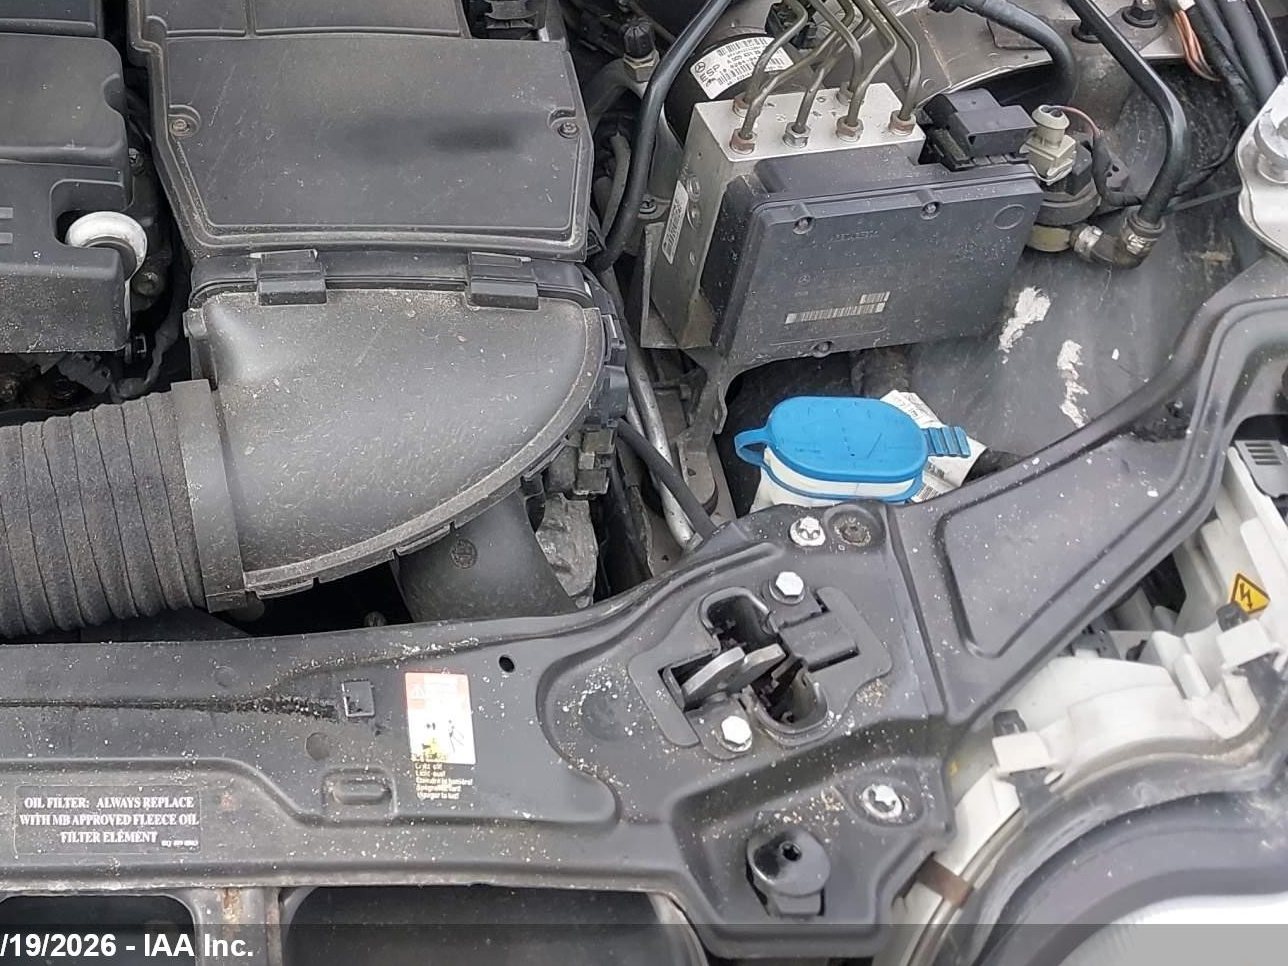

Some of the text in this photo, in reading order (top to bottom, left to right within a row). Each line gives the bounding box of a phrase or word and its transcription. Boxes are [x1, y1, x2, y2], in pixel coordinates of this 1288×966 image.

[699, 63, 721, 83] ESP
[24, 796, 195, 809] OIL FILTER: ALWAYS REPLACE
[19, 814, 200, 826] WITH MB APPROVED FLEECE OIL
[60, 832, 101, 843] FILTER
[103, 831, 158, 843] ELEMENT
